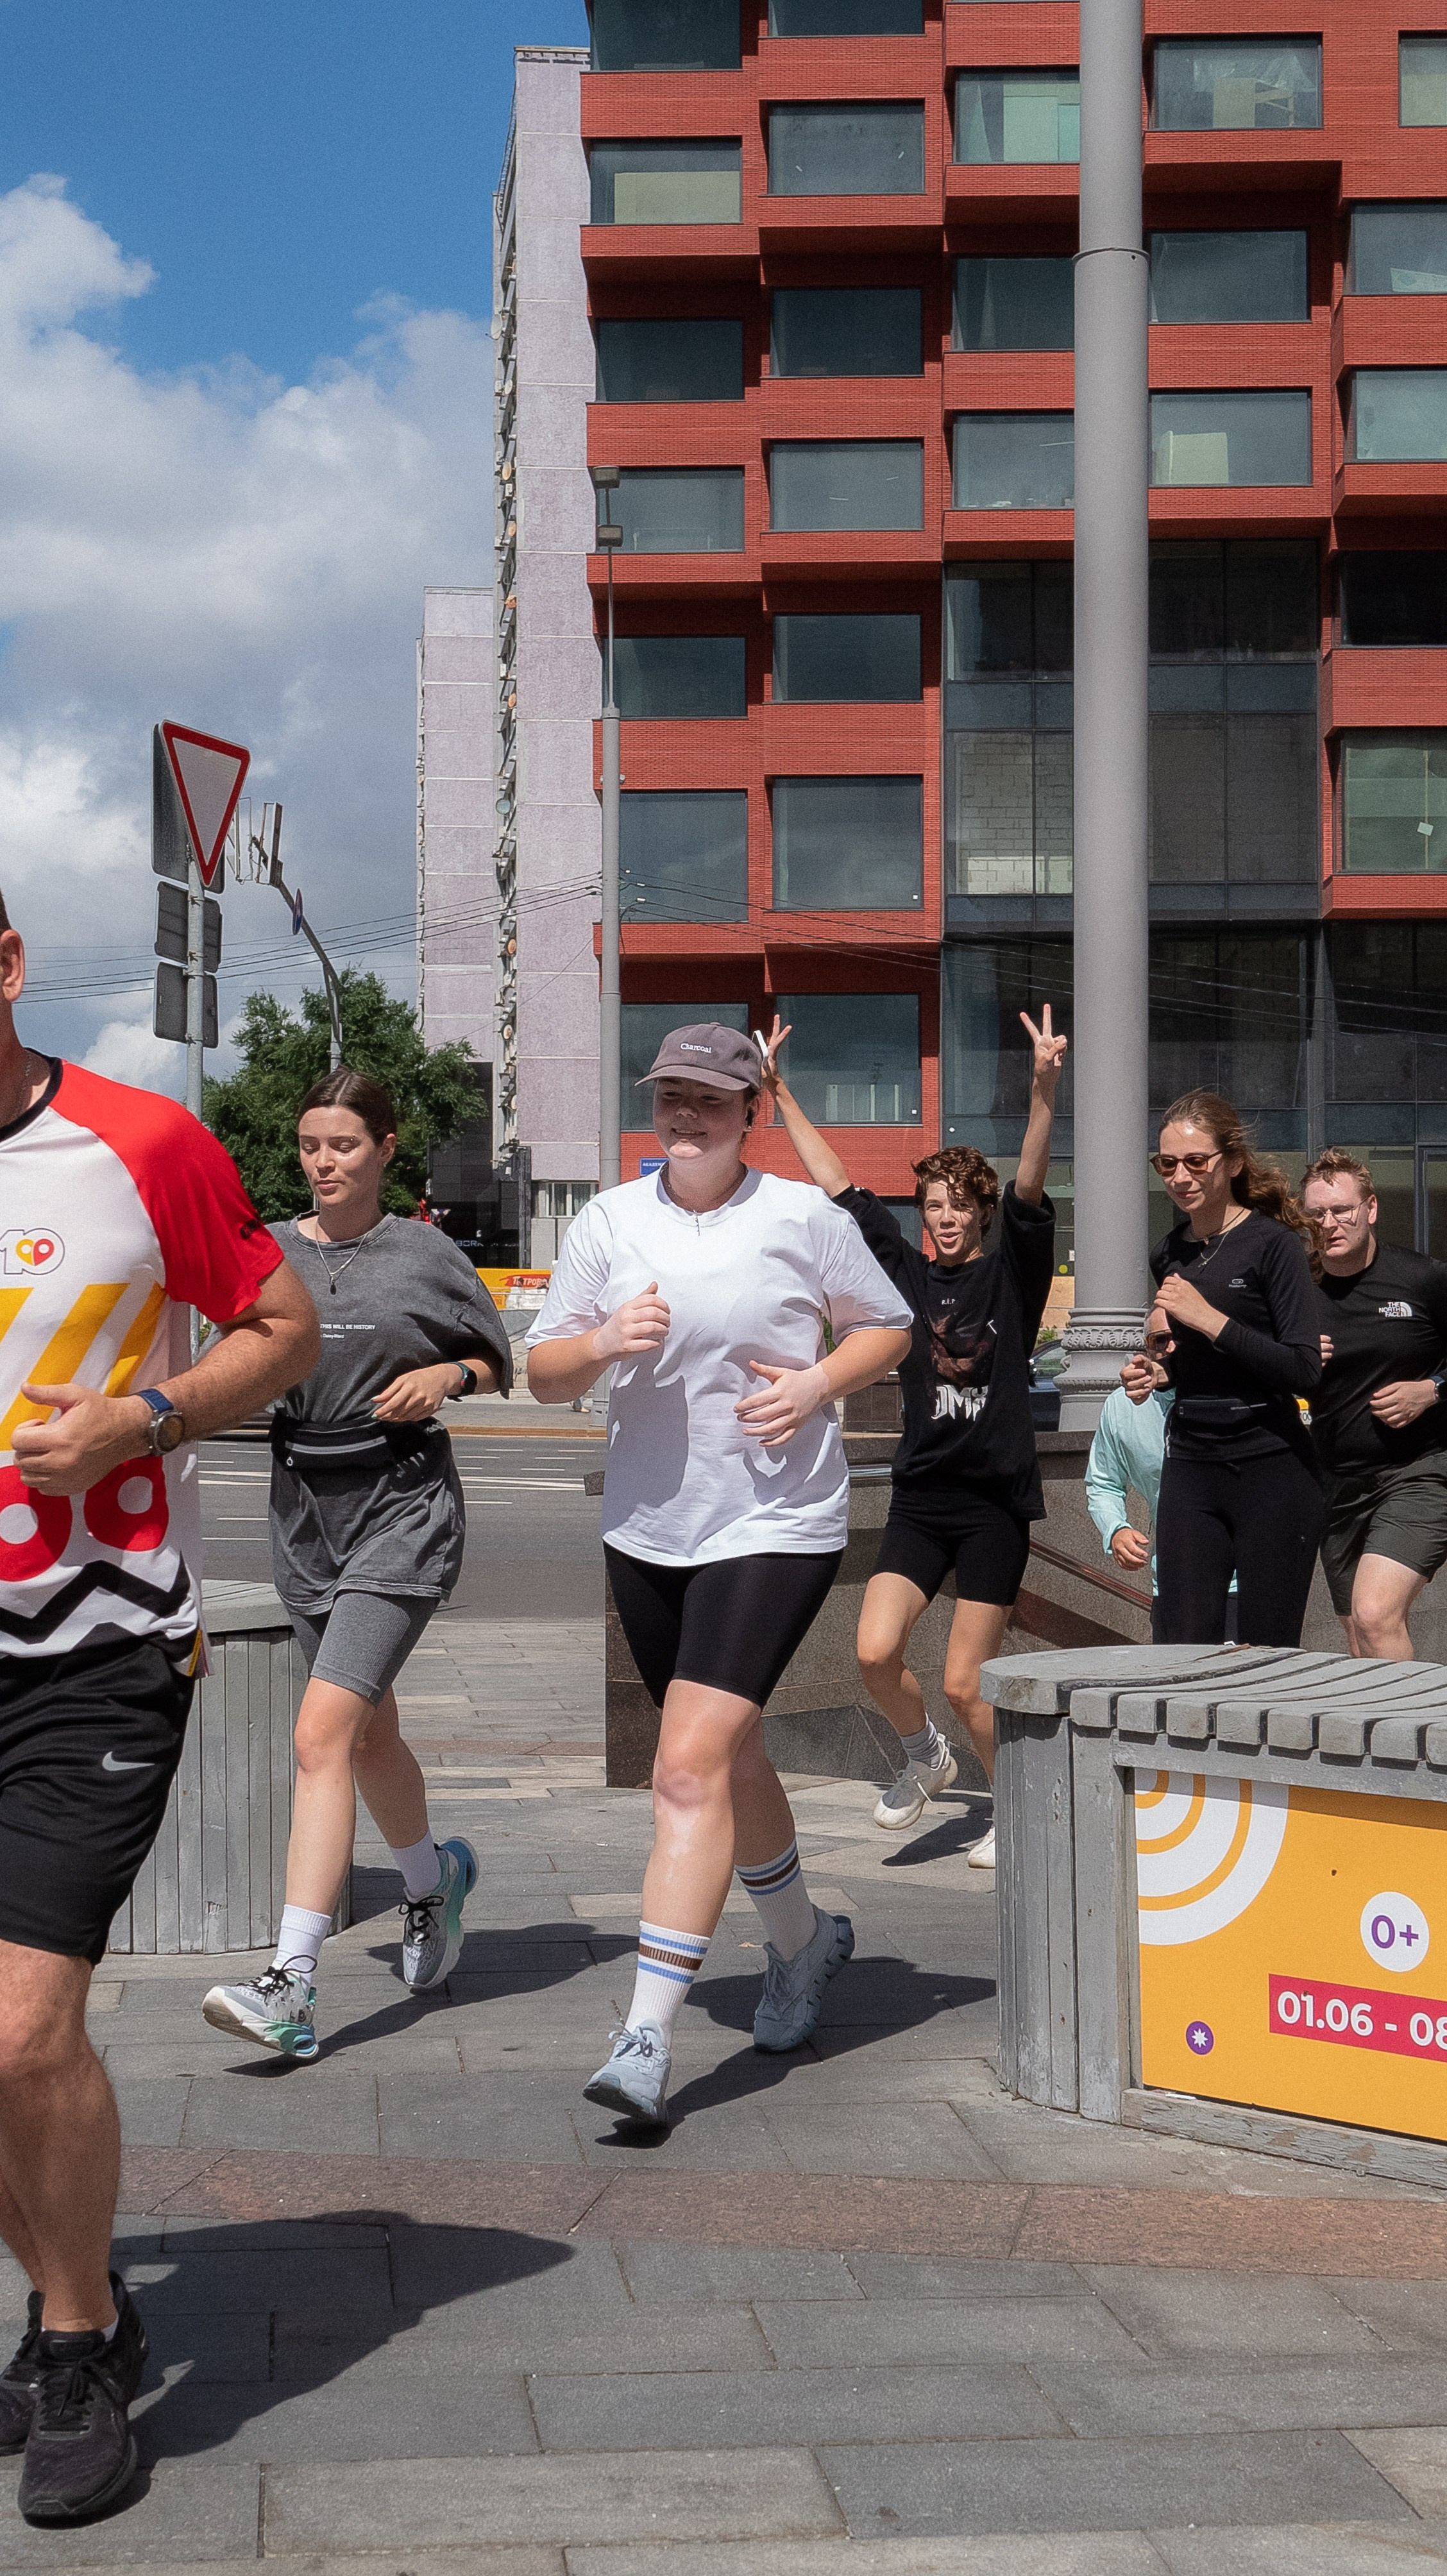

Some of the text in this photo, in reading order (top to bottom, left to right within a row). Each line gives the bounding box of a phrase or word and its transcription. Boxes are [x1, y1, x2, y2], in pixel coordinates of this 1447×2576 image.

[680, 1043, 712, 1054] Charcoal
[1371, 1915, 1419, 1949] 0+
[1277, 1991, 1373, 2036] 01.06
[1385, 2023, 1398, 2032] -
